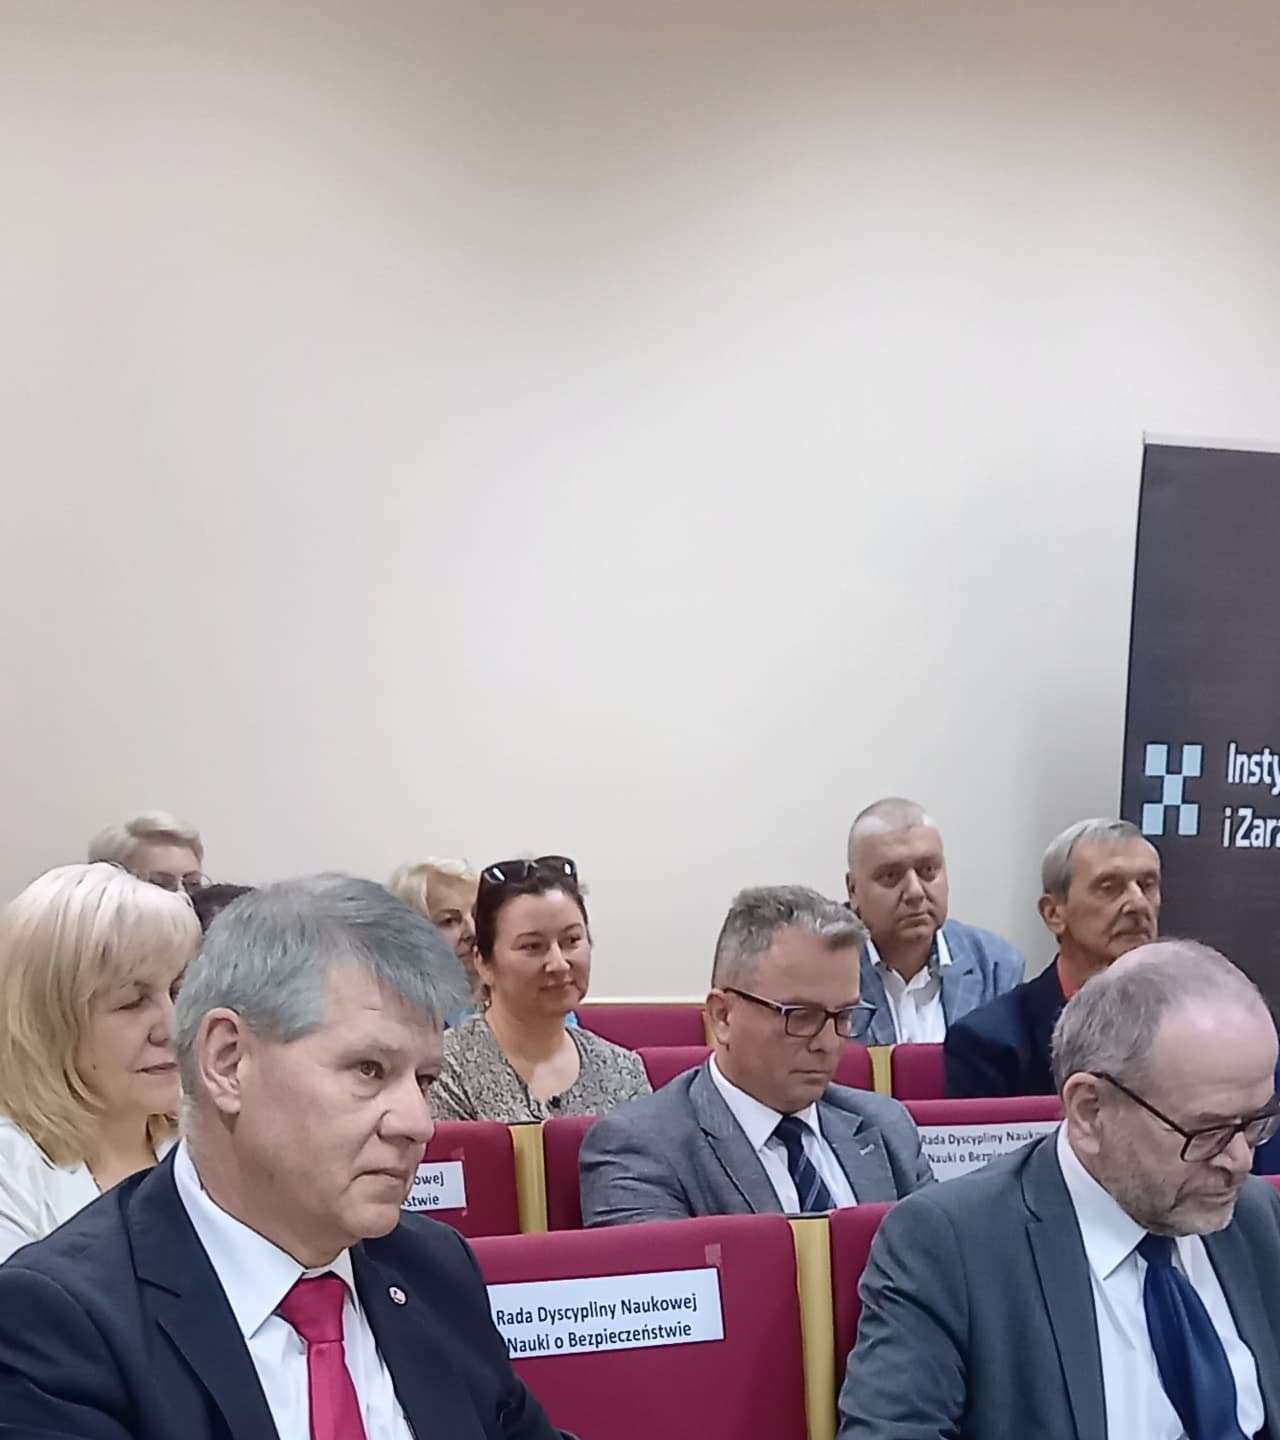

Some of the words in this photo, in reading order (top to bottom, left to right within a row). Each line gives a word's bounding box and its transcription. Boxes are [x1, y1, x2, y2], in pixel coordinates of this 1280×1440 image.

[1222, 806, 1233, 848] i
[920, 1133, 946, 1145] Rada
[948, 1132, 1003, 1147] Dyscypliny
[927, 1152, 957, 1164] Nauki
[959, 1153, 966, 1162] o
[412, 1171, 445, 1187] owej
[496, 1307, 534, 1327] Rada
[537, 1301, 617, 1326] Dyscypliny
[621, 1292, 698, 1315] Naukowej
[506, 1333, 550, 1354] Nauki
[554, 1336, 564, 1350] o
[568, 1321, 693, 1349] Bezpieczeństwie
